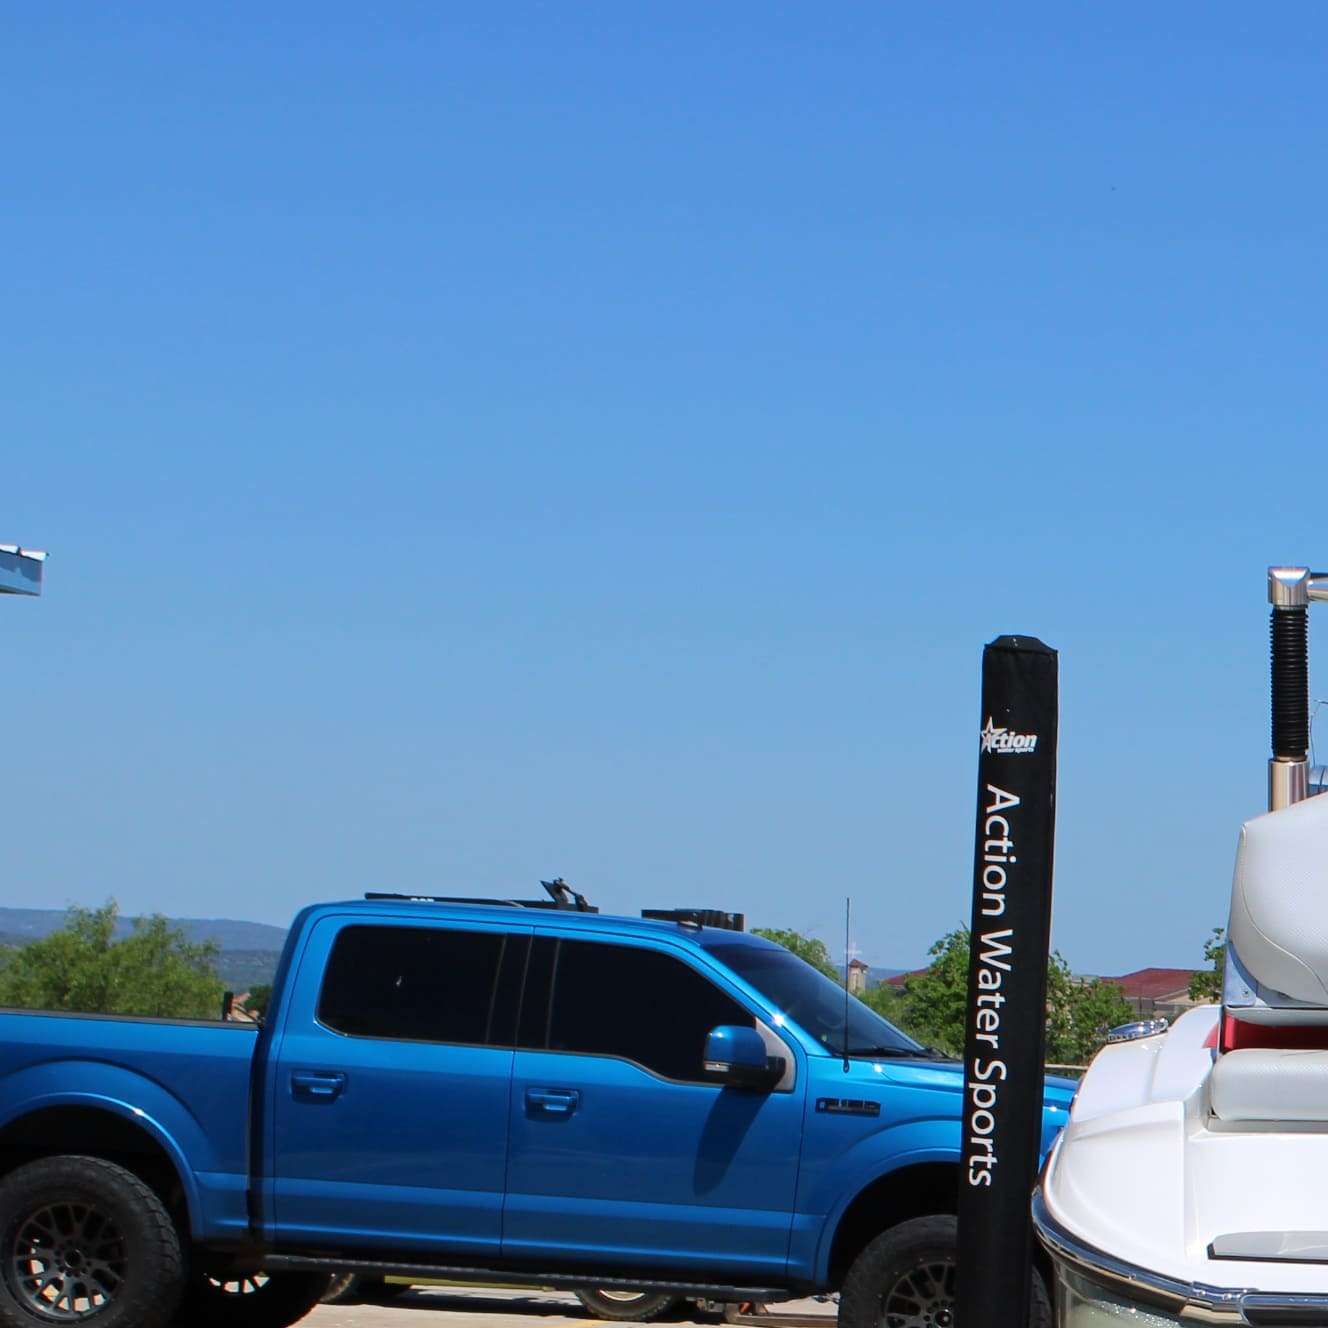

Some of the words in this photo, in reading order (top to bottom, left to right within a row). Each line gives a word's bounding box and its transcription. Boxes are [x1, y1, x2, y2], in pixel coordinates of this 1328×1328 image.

[981, 726, 1038, 753] Action
[981, 783, 1021, 916] Action
[976, 928, 1014, 1049] Water
[968, 1058, 1008, 1187] Sports
